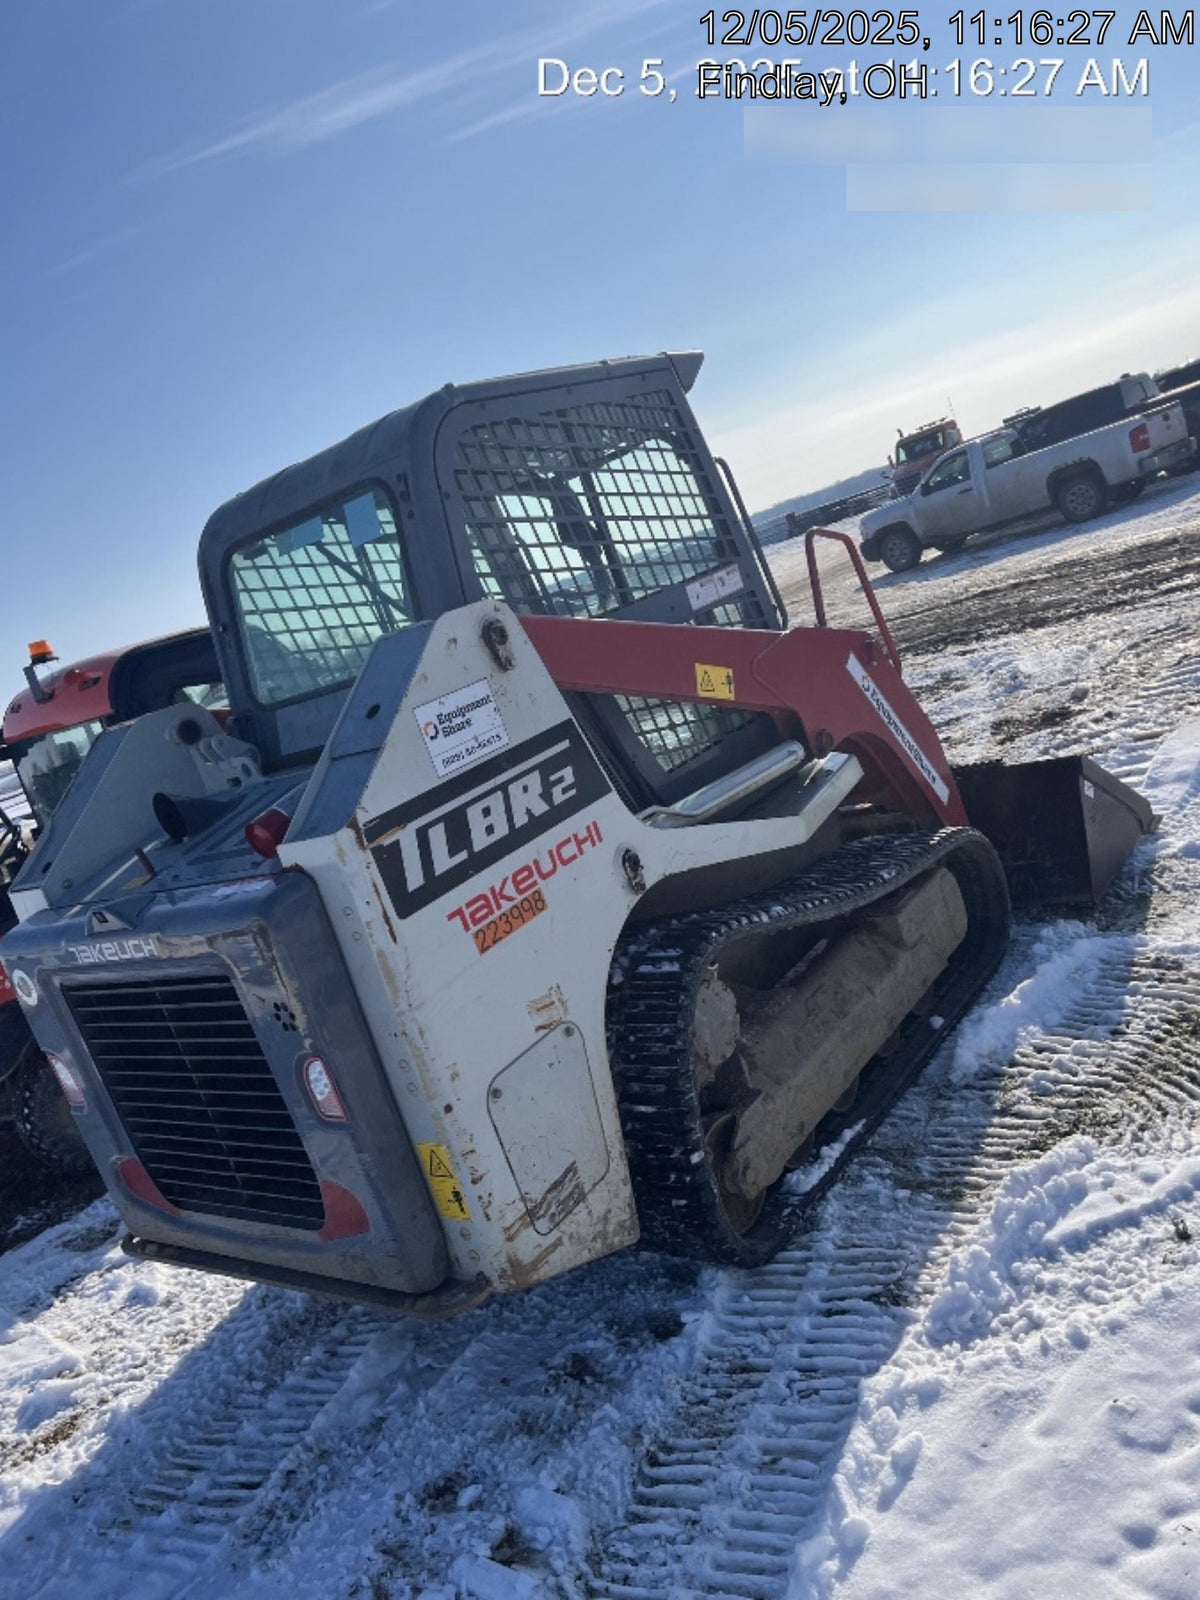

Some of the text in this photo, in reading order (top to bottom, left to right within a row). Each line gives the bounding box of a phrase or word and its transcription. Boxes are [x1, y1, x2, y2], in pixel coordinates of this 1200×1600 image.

[436, 694, 494, 726] Equipment
[441, 718, 472, 738] Share
[474, 888, 547, 953] 223998
